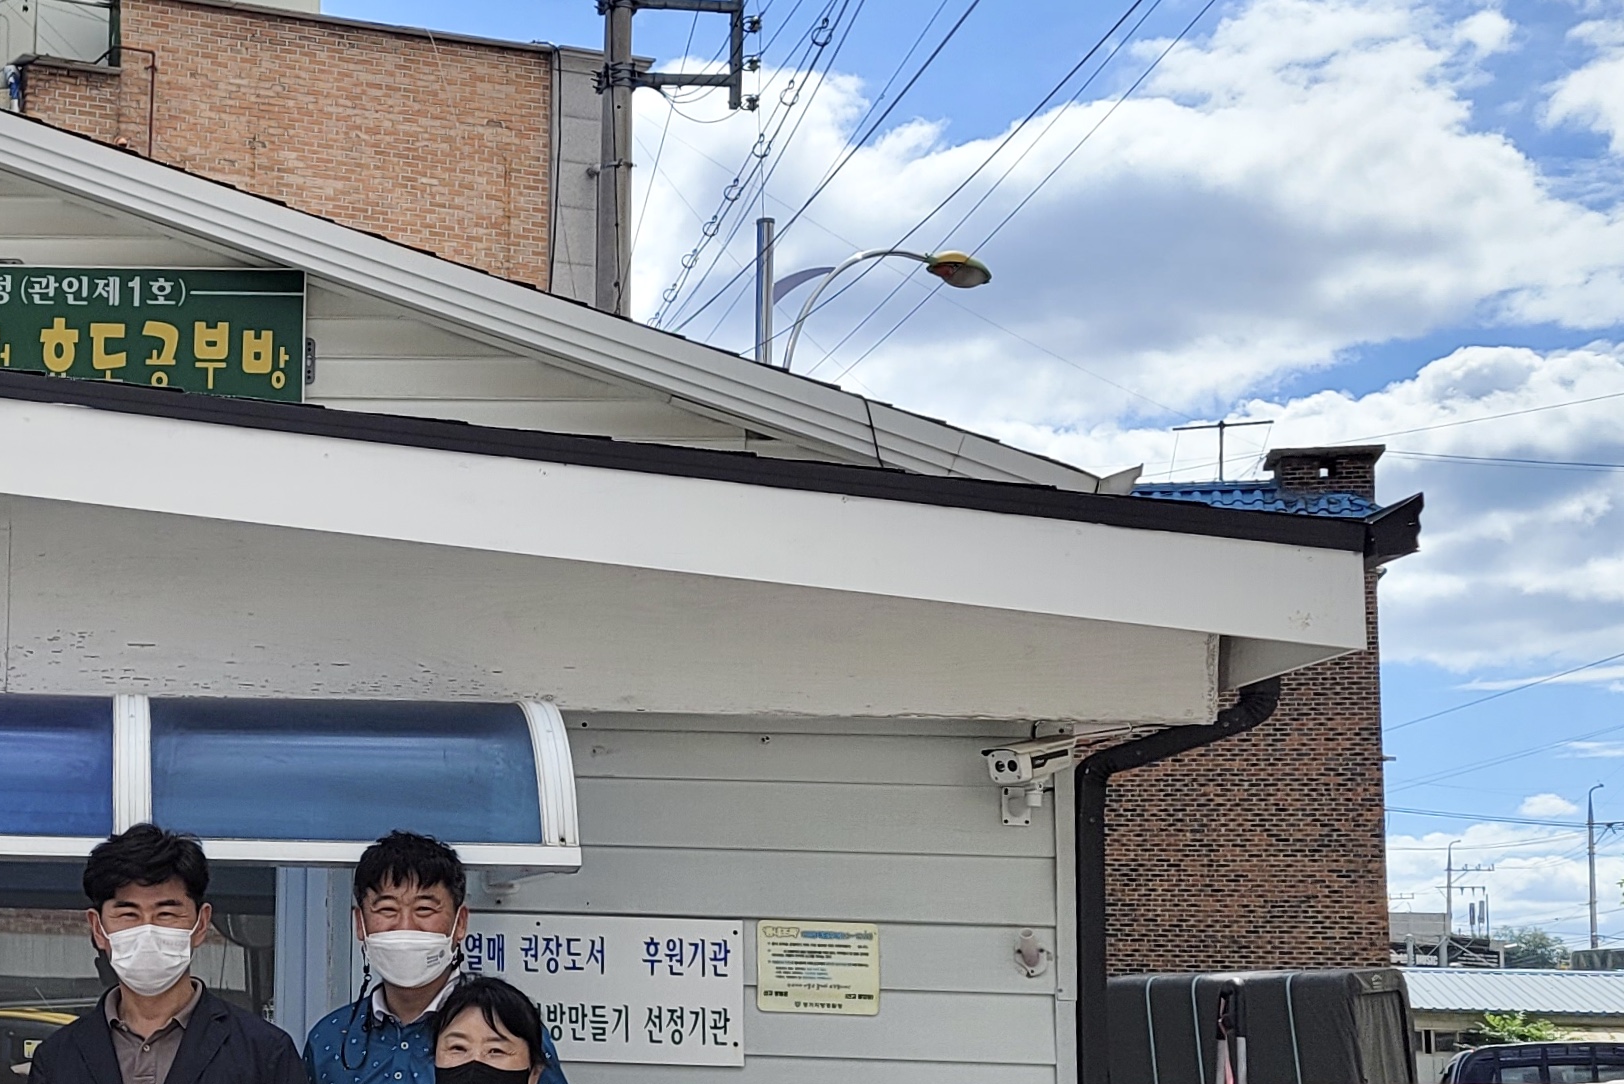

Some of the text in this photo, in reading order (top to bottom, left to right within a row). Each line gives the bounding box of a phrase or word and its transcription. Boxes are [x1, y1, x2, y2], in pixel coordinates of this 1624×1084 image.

[465, 933, 505, 972] 열매
[520, 936, 606, 974] 권장도서
[642, 938, 731, 977] 후원기관
[538, 1003, 730, 1046] 방만들기 선정기관
